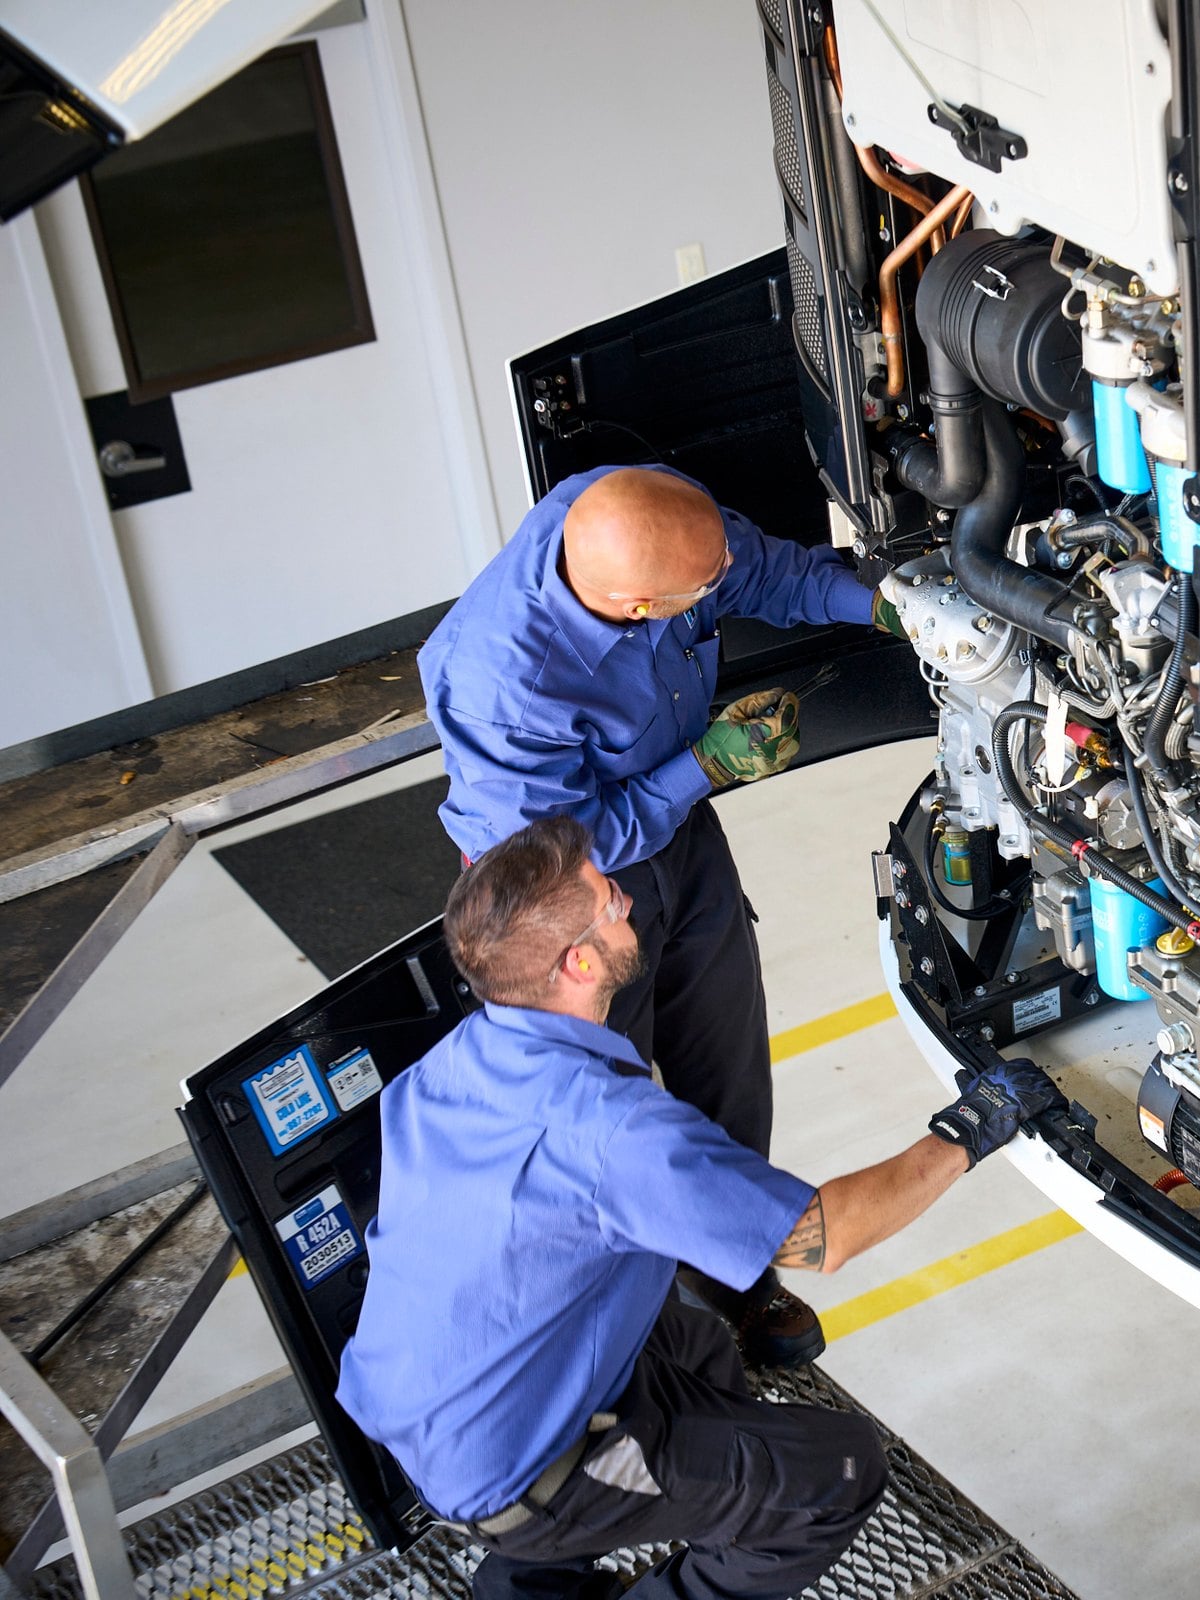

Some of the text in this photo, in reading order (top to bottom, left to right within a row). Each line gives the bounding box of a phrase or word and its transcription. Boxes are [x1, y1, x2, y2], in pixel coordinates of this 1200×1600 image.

[295, 1234, 309, 1253] R
[308, 1212, 341, 1243] 452A
[304, 1233, 351, 1271] 2030513
